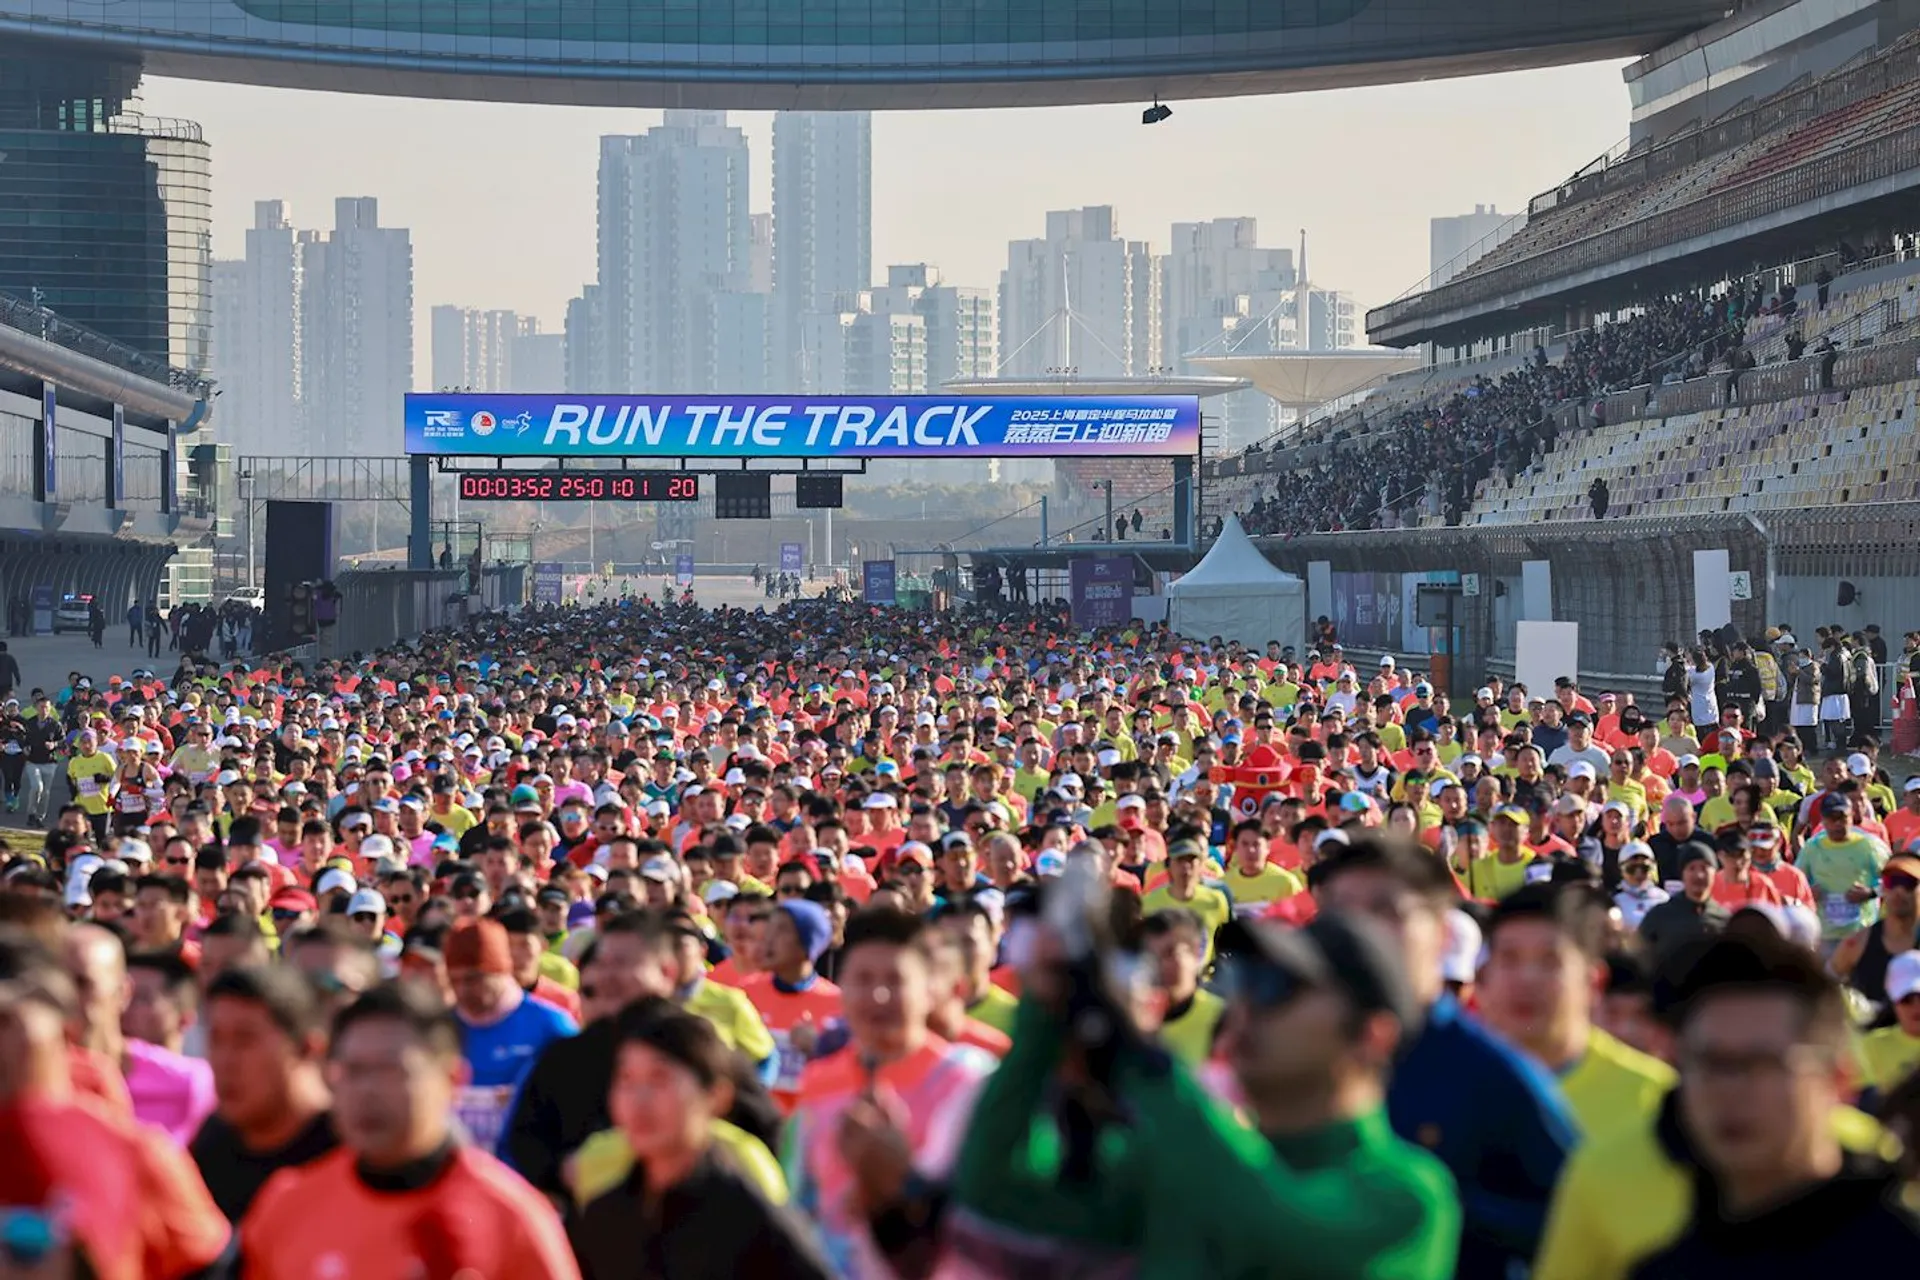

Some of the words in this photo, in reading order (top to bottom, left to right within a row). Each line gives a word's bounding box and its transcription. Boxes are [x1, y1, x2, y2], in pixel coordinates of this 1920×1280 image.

[543, 405, 671, 446] RUN
[685, 405, 792, 446] THE
[804, 405, 994, 446] TRACK
[1002, 423, 1174, 443] 蒸蒸日上迎新跑
[464, 478, 550, 496] 00:03:52
[669, 478, 695, 496] 20
